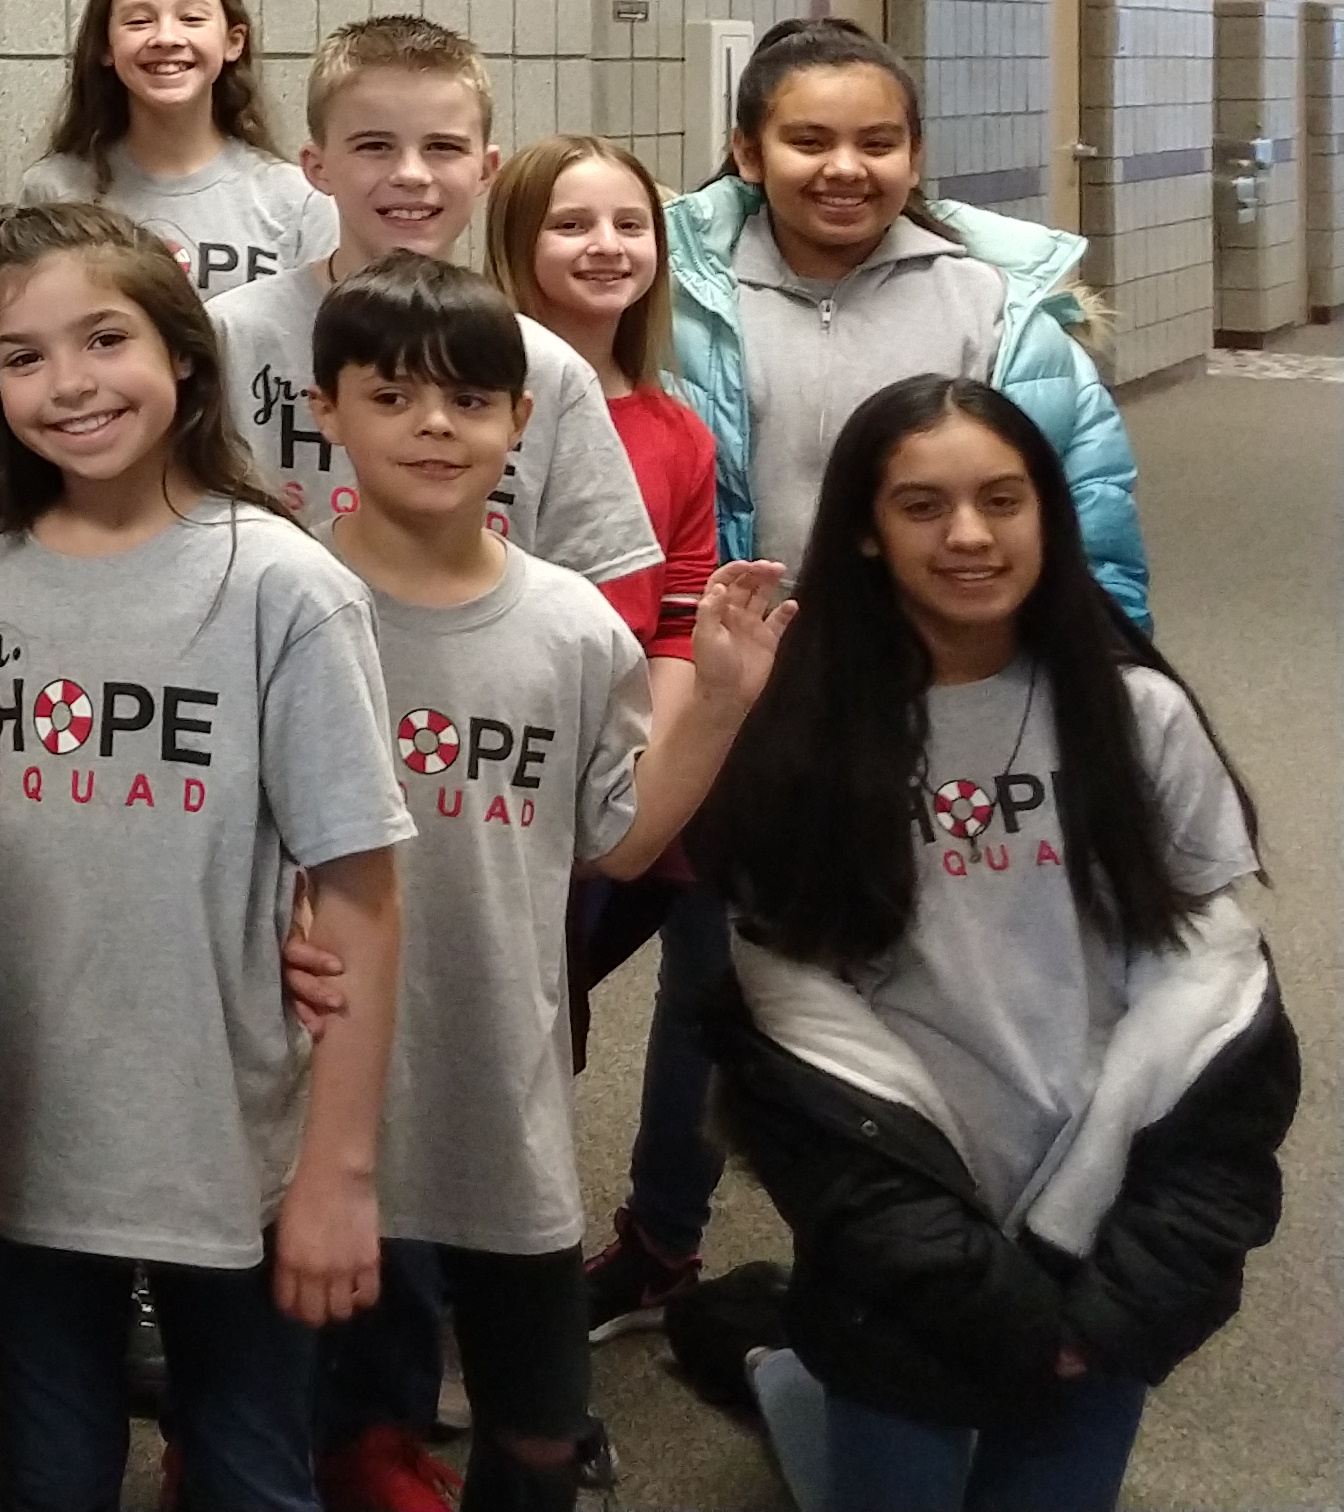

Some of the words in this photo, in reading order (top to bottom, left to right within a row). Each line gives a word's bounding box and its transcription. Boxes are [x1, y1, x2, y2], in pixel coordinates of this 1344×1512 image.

[251, 364, 312, 425] Jr.
[396, 707, 556, 791] OPE
[943, 840, 1061, 876] QUA
